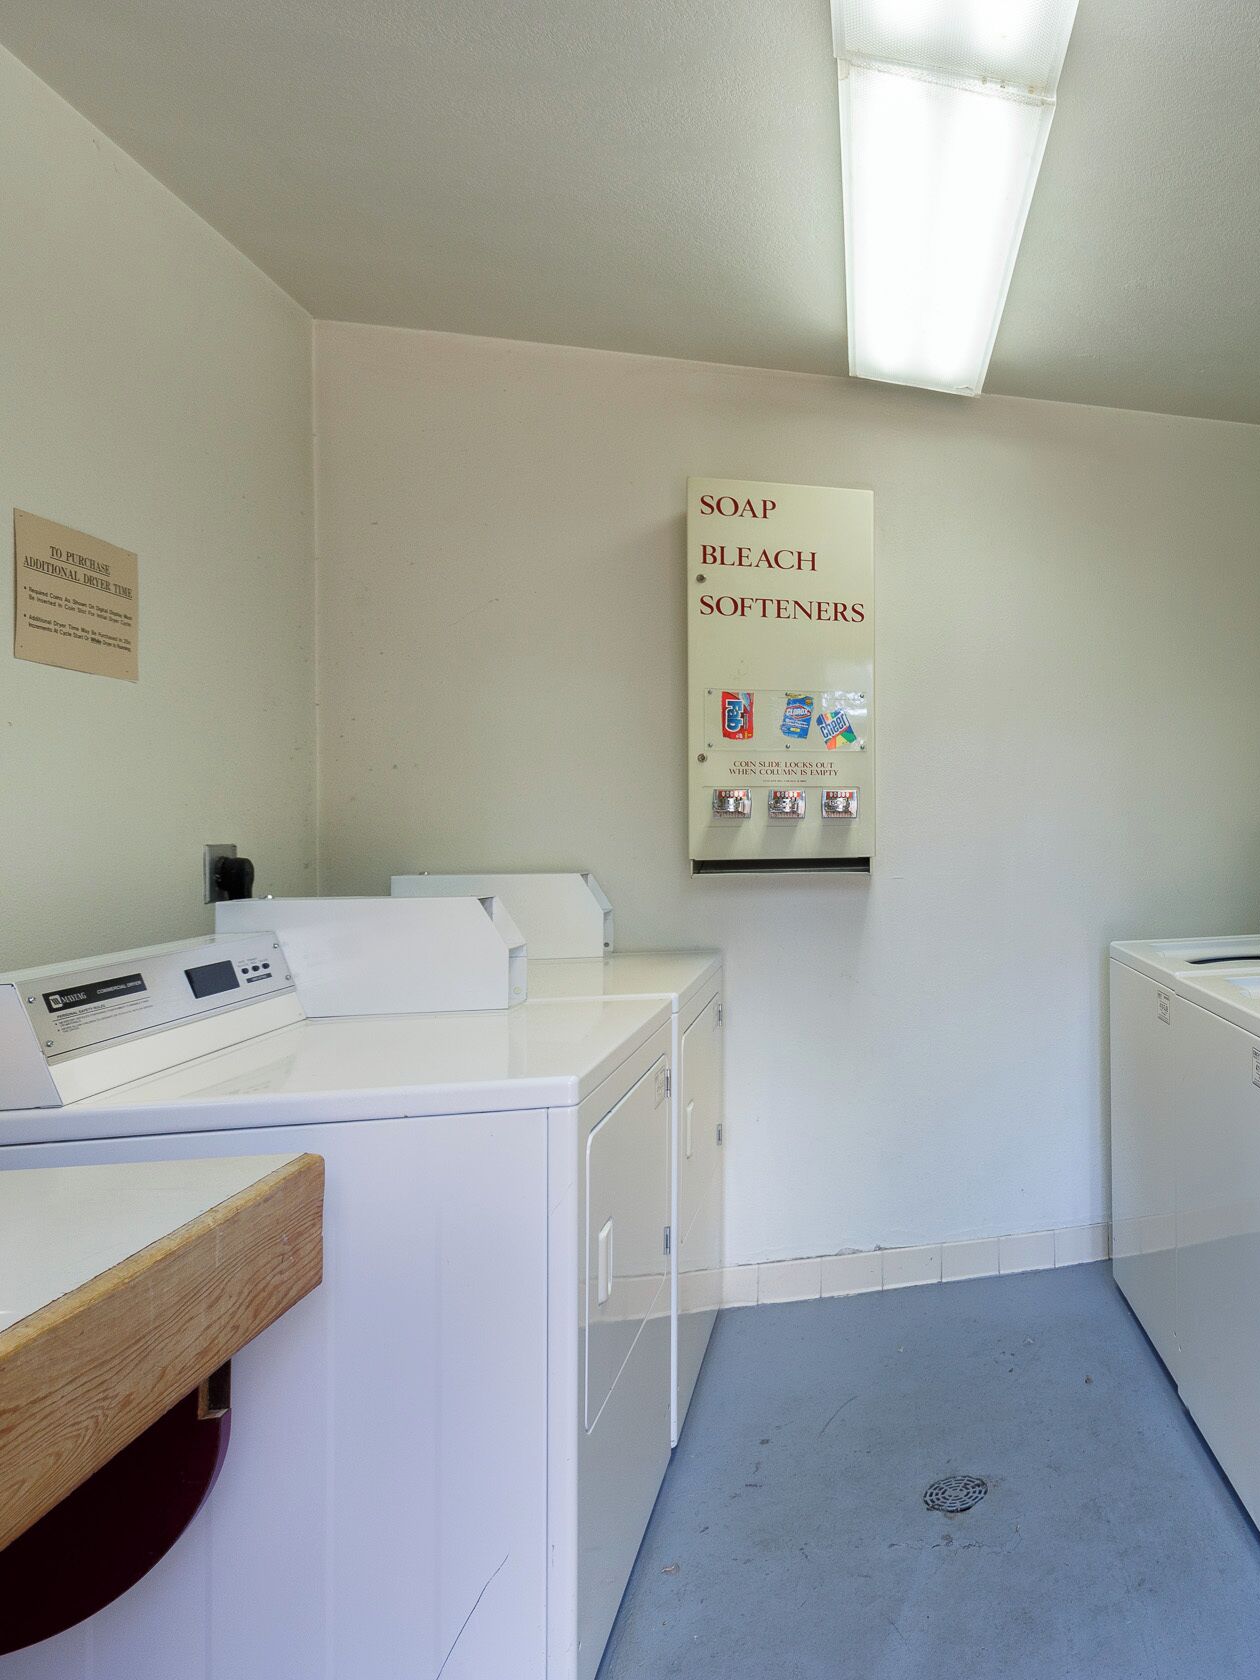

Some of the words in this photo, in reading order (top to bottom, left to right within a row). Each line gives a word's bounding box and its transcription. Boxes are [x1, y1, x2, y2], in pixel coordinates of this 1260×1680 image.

[700, 494, 777, 519] SOAP
[50, 546, 62, 558] TO
[67, 551, 110, 575] PURCHASE
[701, 544, 817, 572] BLEACH
[24, 556, 79, 581] ADDITIONAL
[84, 573, 111, 591] DRYER
[113, 584, 132, 598] TIME
[699, 594, 865, 623] SOFTENERS
[726, 699, 743, 732] Fab
[820, 713, 847, 739] cheer
[785, 761, 813, 769] LOCKS
